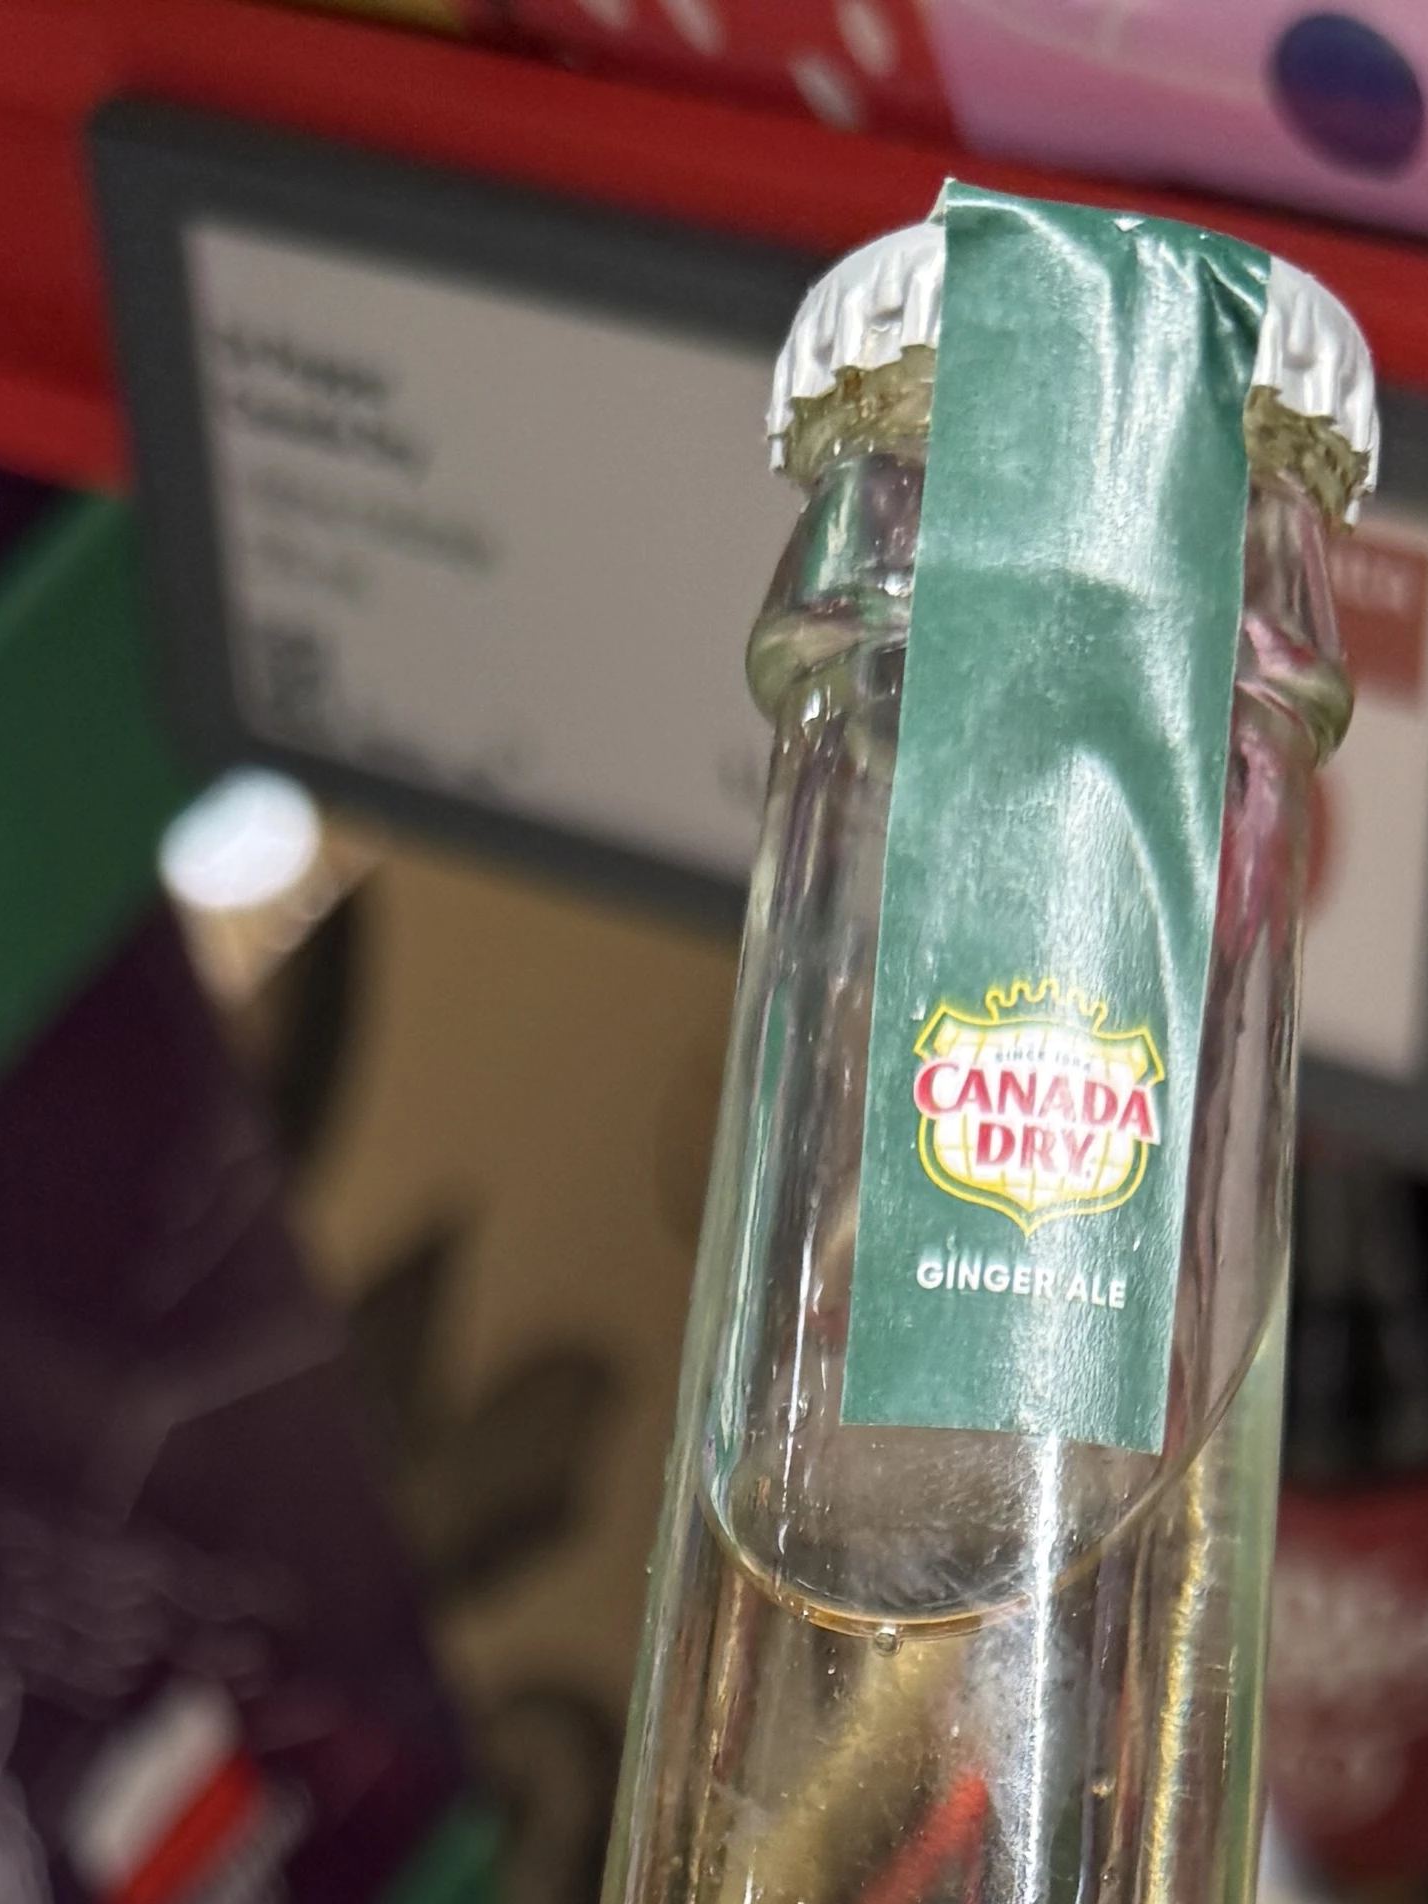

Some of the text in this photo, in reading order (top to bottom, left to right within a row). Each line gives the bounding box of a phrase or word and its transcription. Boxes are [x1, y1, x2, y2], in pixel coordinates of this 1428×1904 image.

[916, 1061, 1154, 1138] CANADA
[975, 1121, 1095, 1177] DRY
[916, 1258, 1127, 1310] GINGER ALE
